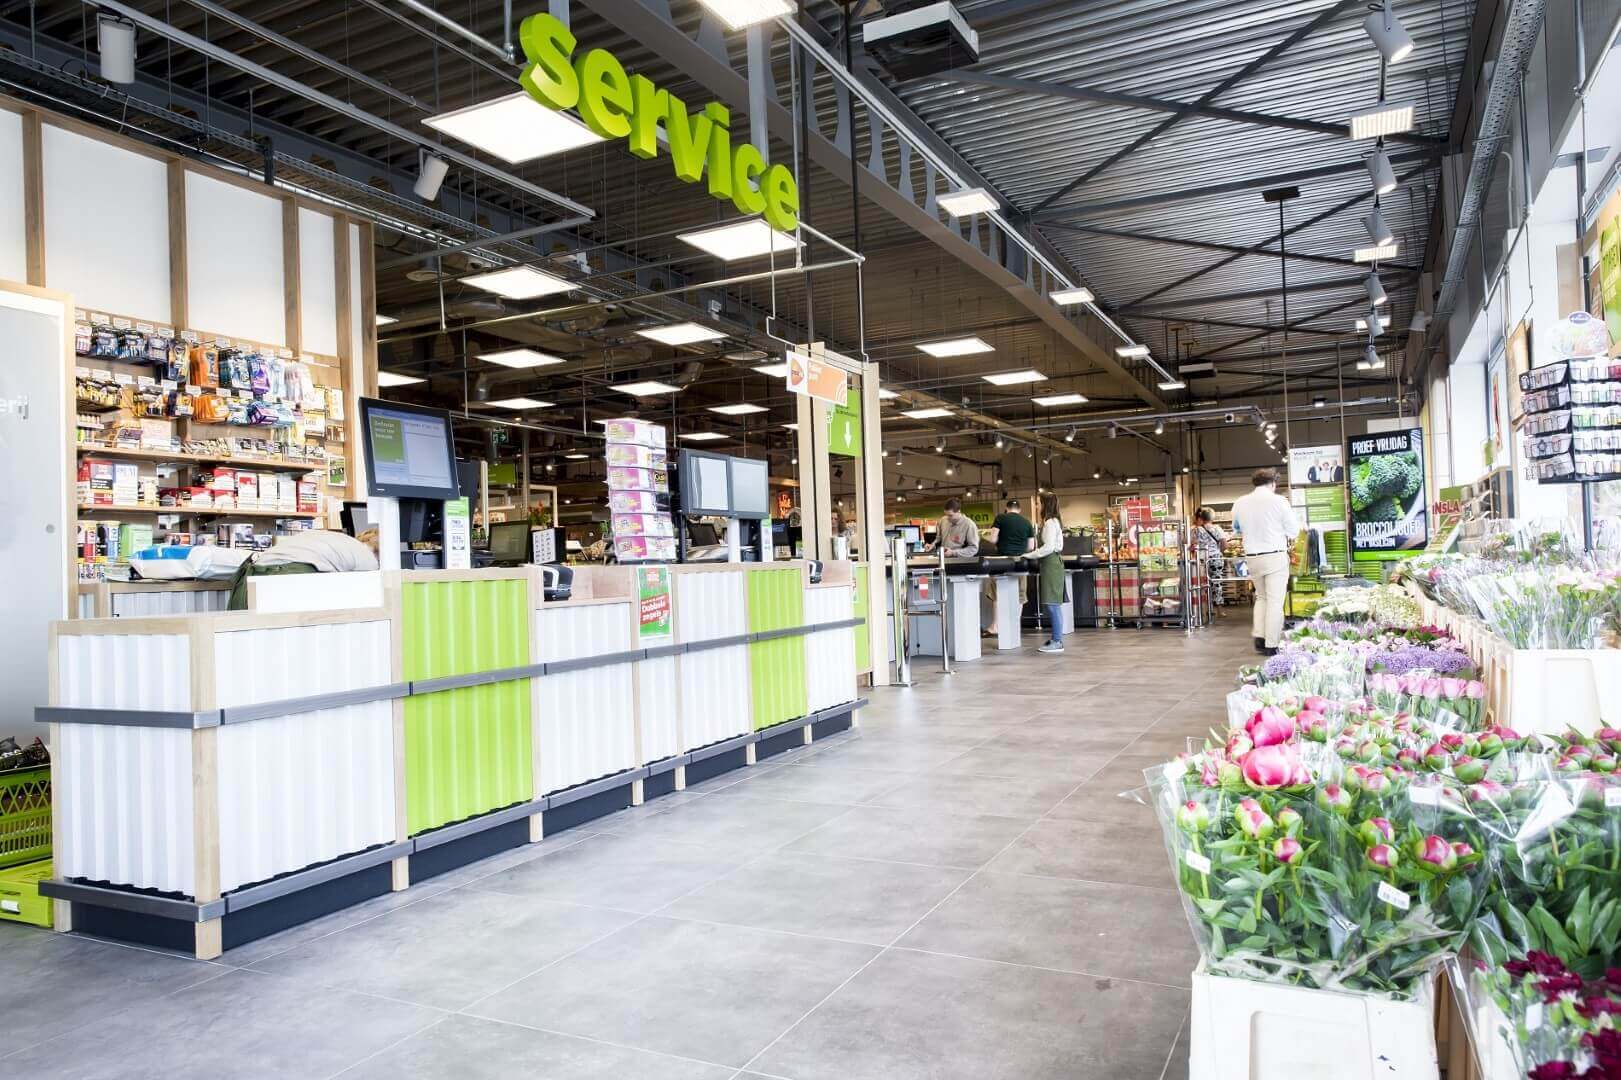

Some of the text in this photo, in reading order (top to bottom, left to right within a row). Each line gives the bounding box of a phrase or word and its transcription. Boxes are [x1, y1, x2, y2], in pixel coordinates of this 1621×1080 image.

[519, 12, 799, 232] Service
[1352, 436, 1407, 455] PROEF VRIJDAG
